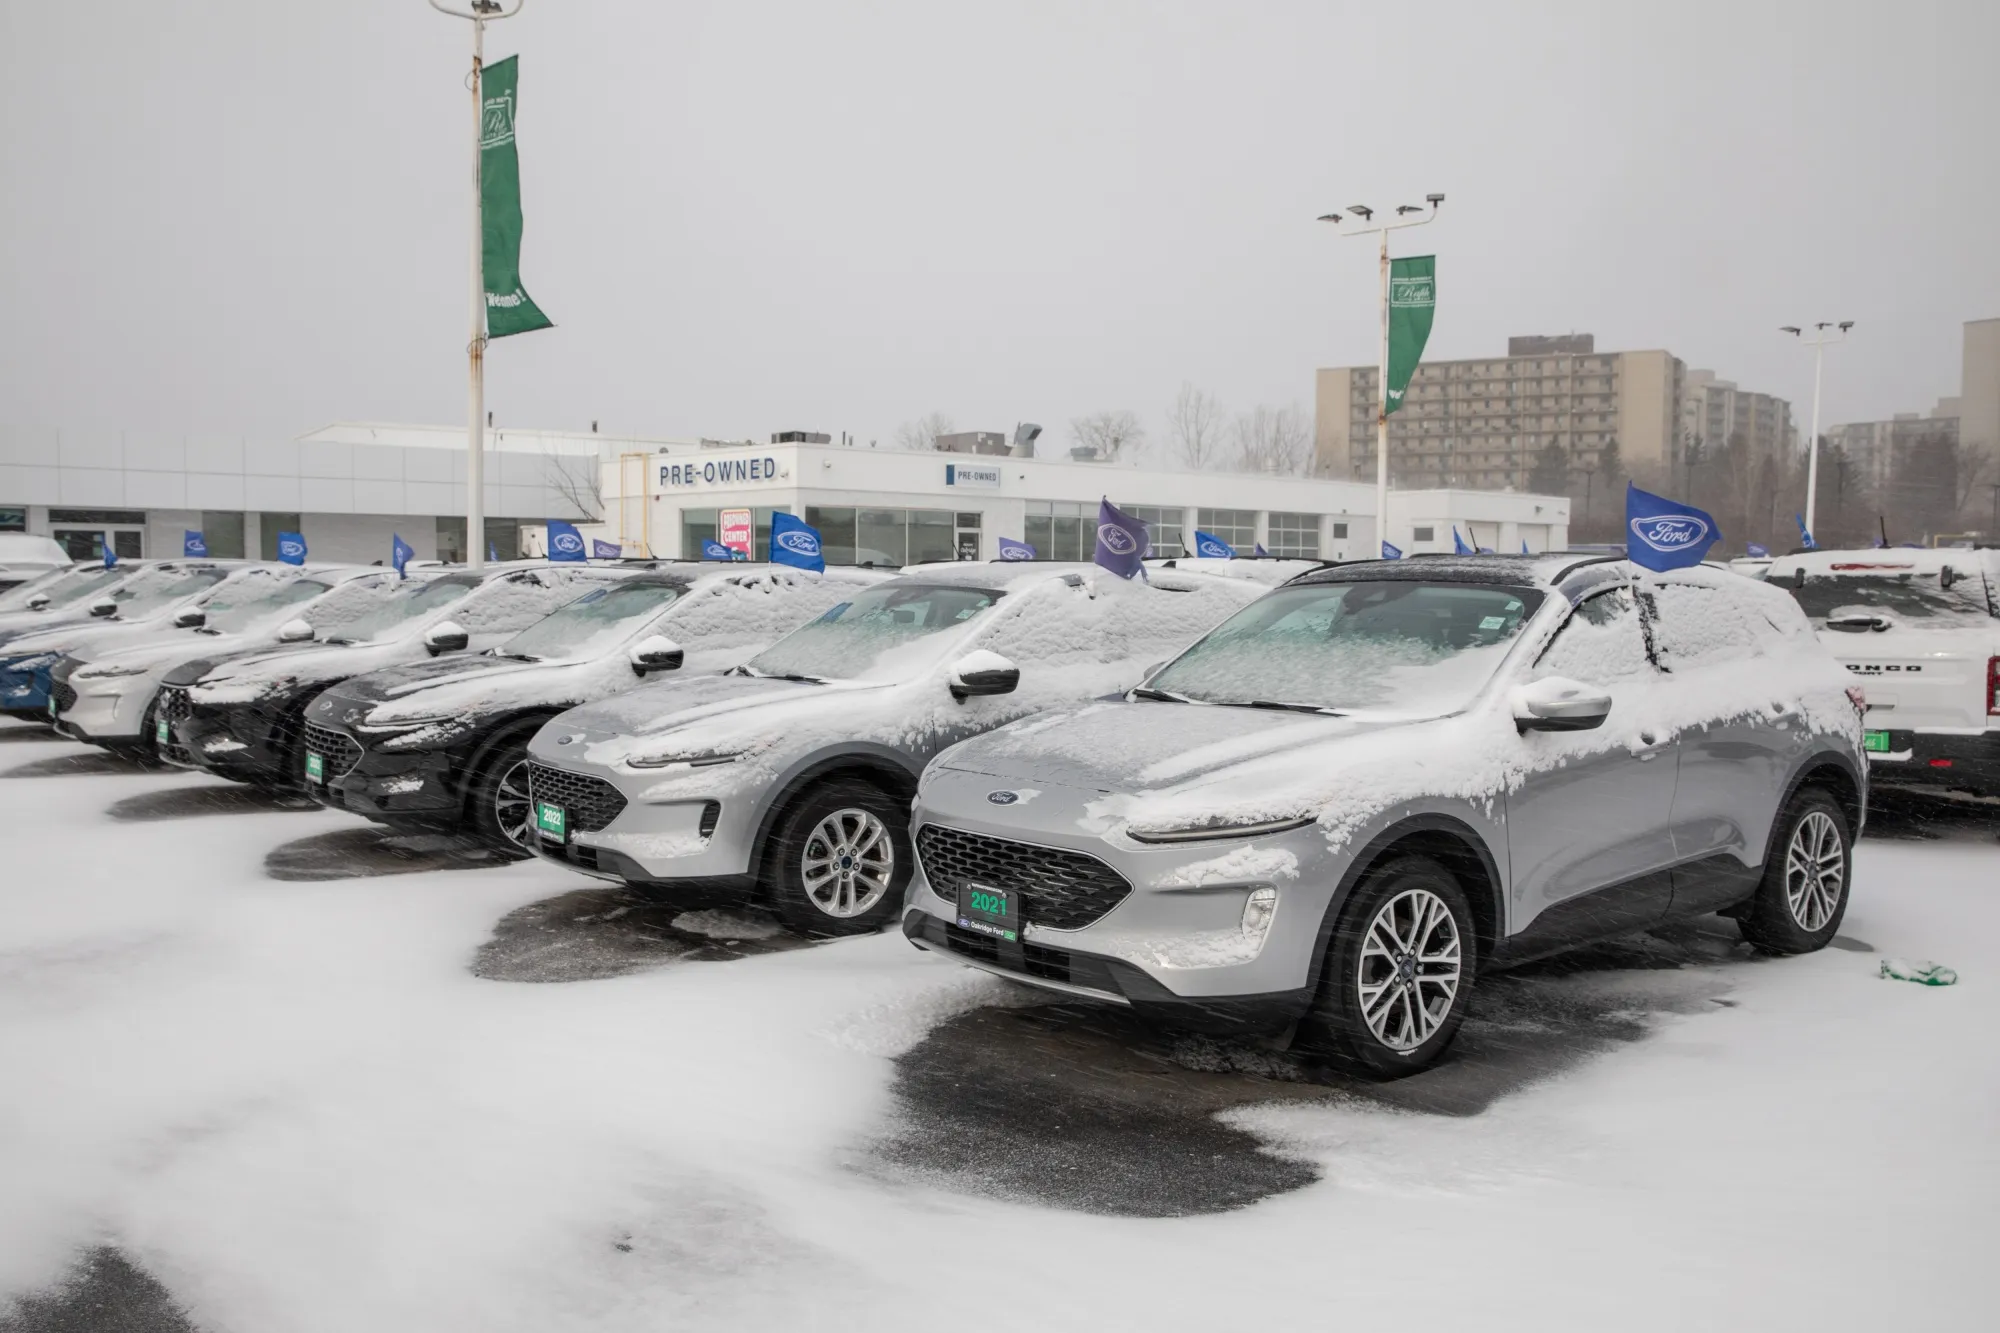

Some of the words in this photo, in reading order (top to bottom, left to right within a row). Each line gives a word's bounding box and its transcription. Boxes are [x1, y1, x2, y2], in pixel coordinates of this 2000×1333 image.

[660, 457, 775, 486] PRE-OWNED
[958, 471, 996, 481] PRE-OWNED
[724, 530, 747, 542] CENTER
[1107, 528, 1126, 549] Ford
[1648, 521, 1693, 542] Ford
[789, 535, 815, 551] Ford
[1845, 664, 1922, 672] ONCO
[991, 792, 1013, 802] Ford
[543, 808, 561, 826] 2022
[971, 891, 1006, 916] 2021
[970, 921, 993, 934] Oakridge
[993, 927, 1004, 937] Ford
